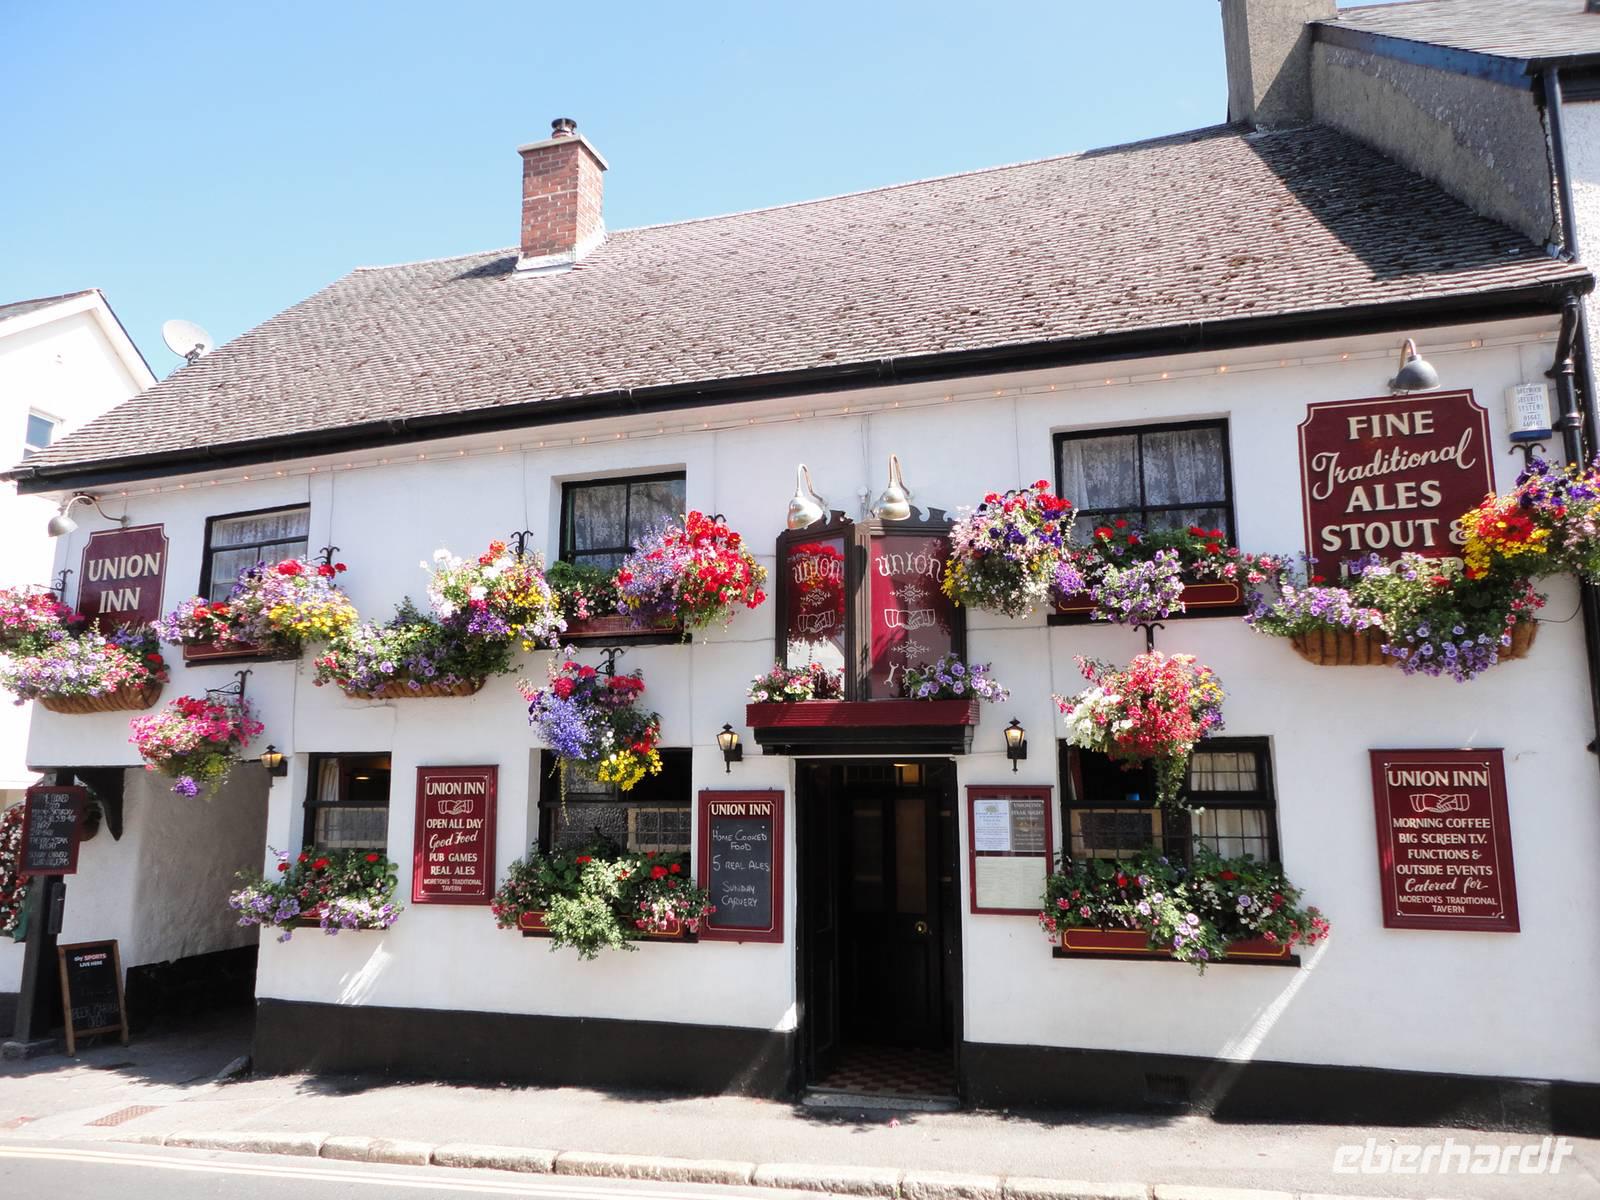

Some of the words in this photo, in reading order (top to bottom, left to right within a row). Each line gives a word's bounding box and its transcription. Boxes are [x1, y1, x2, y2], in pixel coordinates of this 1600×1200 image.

[1348, 410, 1434, 440] FINE
[1312, 427, 1476, 500] Traditional
[1345, 480, 1442, 513] ALES
[1321, 518, 1439, 552] STOUT
[88, 552, 161, 582] UNION
[98, 587, 140, 614] INN
[1388, 770, 1449, 787] UNION
[1453, 770, 1488, 787] INN
[426, 782, 462, 796] UNION
[464, 782, 485, 795] INN
[711, 804, 746, 816] UNION
[749, 804, 771, 816] INN
[426, 819, 448, 829] OPEN
[448, 819, 465, 829] ALL
[466, 818, 484, 829] DAY
[1393, 818, 1443, 829] MORNING
[1446, 818, 1491, 829] COFFEE
[429, 833, 455, 854] Good
[454, 830, 479, 846] Food
[1398, 834, 1418, 844] BIG
[1422, 833, 1467, 845] SCREEN
[429, 853, 445, 862] PUB
[448, 853, 478, 863] GAMES
[1407, 850, 1470, 860] FUNCTIONS
[1471, 850, 1482, 860] &
[712, 854, 722, 873] 5
[1396, 864, 1444, 876] OUTSIDE
[1447, 865, 1493, 876] EVENTS
[430, 866, 453, 876] REAL
[454, 866, 476, 876] ALES
[1405, 877, 1458, 893] Catered
[1463, 877, 1489, 895] for
[1445, 896, 1498, 906] TRADITIONAL
[1431, 905, 1465, 914] TAVERN
